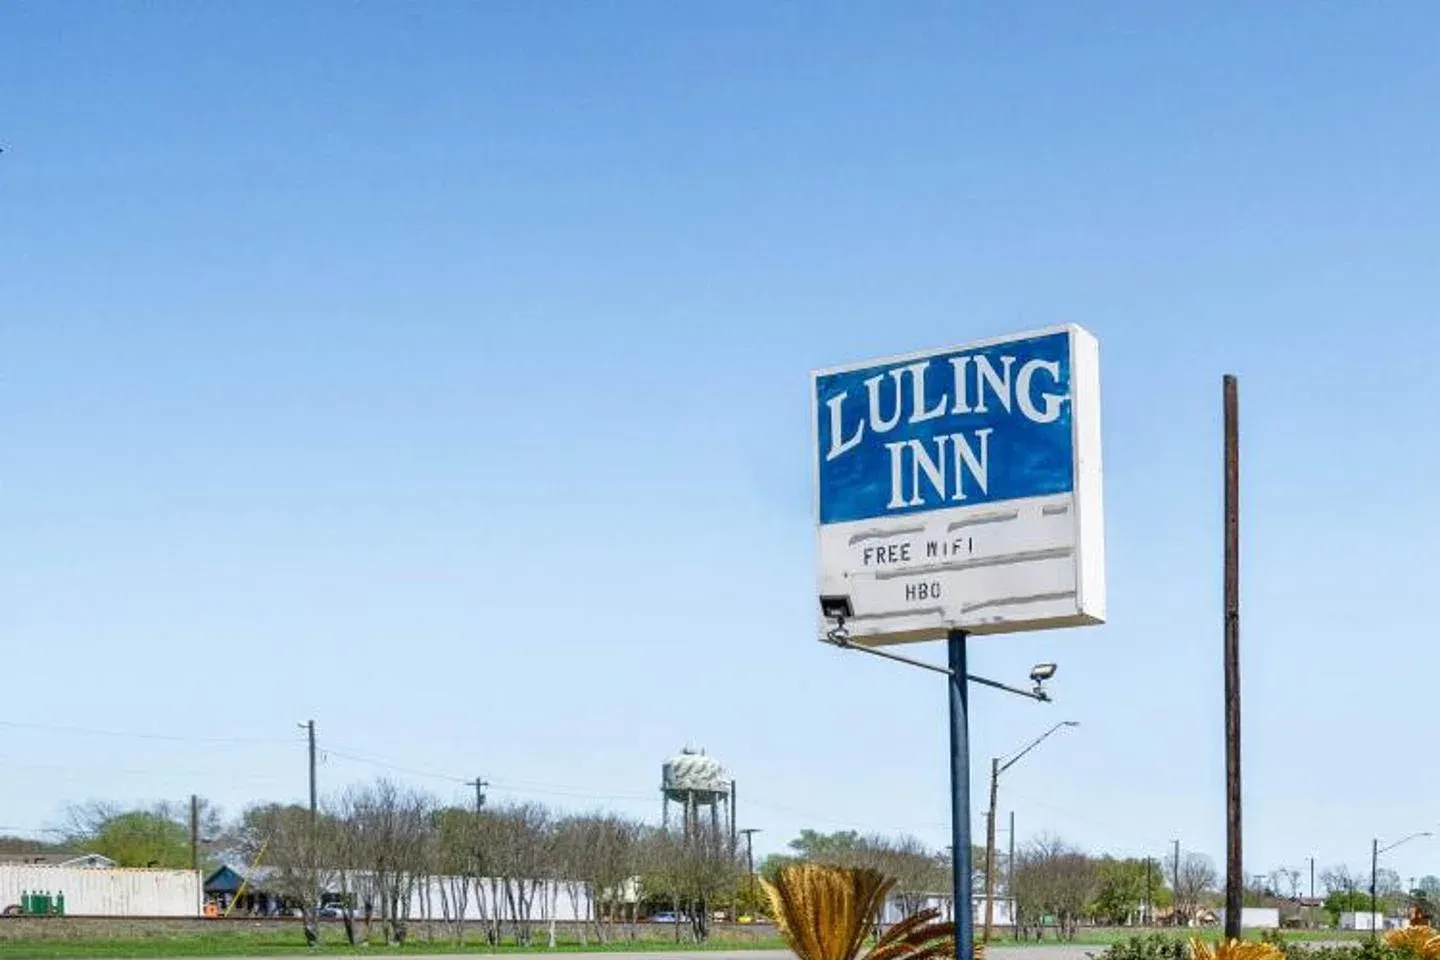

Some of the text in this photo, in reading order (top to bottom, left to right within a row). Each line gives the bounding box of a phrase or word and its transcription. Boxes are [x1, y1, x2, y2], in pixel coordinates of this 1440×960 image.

[826, 355, 1070, 461] LULING
[885, 428, 993, 509] INN
[863, 542, 911, 566] FREE
[905, 582, 941, 601] HBO
